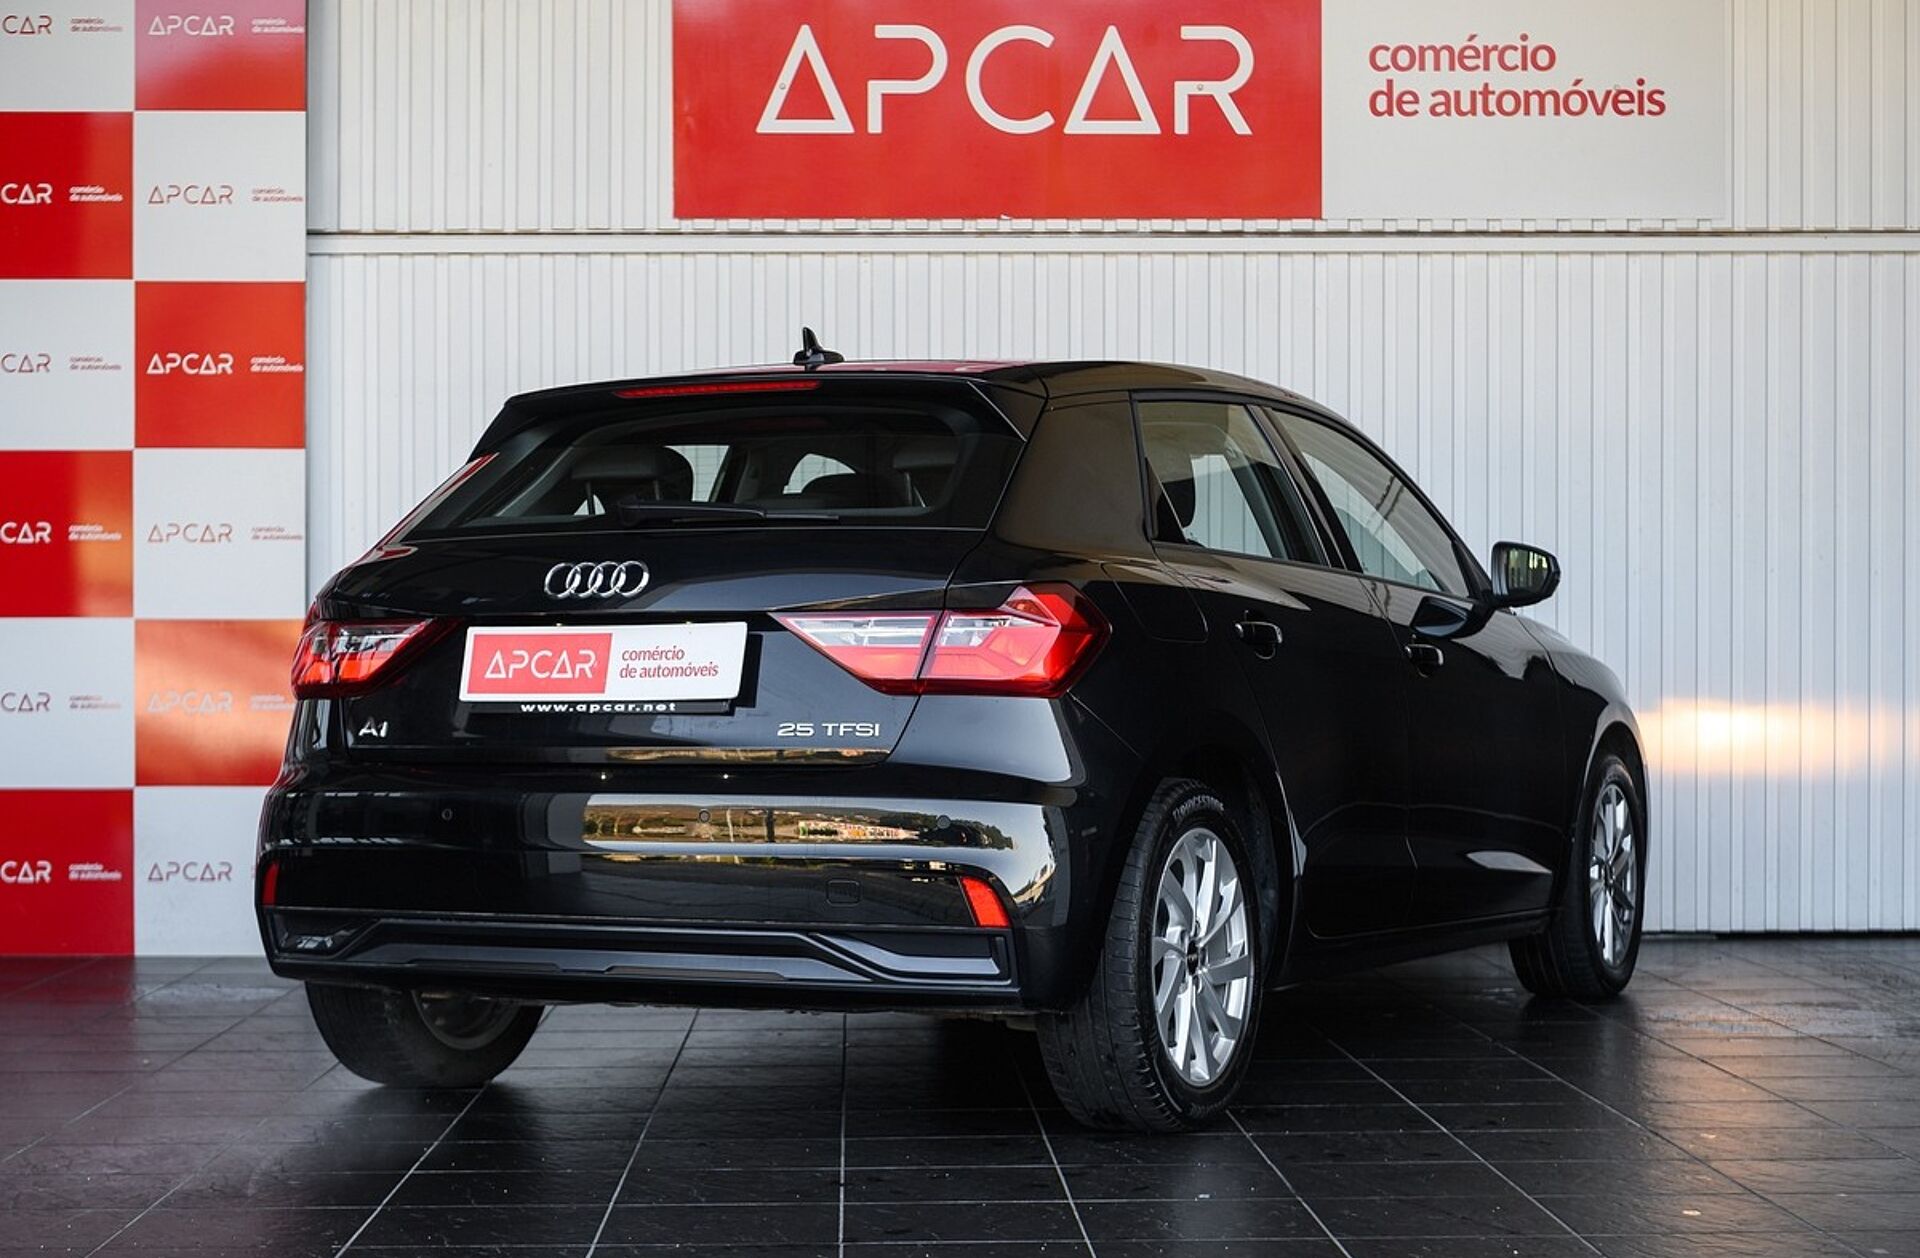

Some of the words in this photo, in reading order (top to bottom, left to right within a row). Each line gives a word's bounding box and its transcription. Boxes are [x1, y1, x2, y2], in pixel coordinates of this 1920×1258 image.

[148, 15, 235, 36] APCAR
[1369, 33, 1557, 73] comércio
[756, 24, 1254, 135] APCAR
[1369, 78, 1418, 118] de
[1429, 78, 1667, 118] automóveis
[148, 184, 234, 204] APCAR
[146, 352, 234, 375] APCAR
[147, 523, 233, 543] APCAR
[621, 645, 685, 661] comércio
[484, 649, 597, 679] APCAR
[619, 663, 637, 679] de
[639, 661, 719, 679] automóveis
[520, 702, 676, 714] www.apcar.net
[358, 720, 389, 738] A1
[776, 722, 815, 737] 25
[821, 722, 880, 737] TFSI
[148, 861, 233, 882] APCAR
